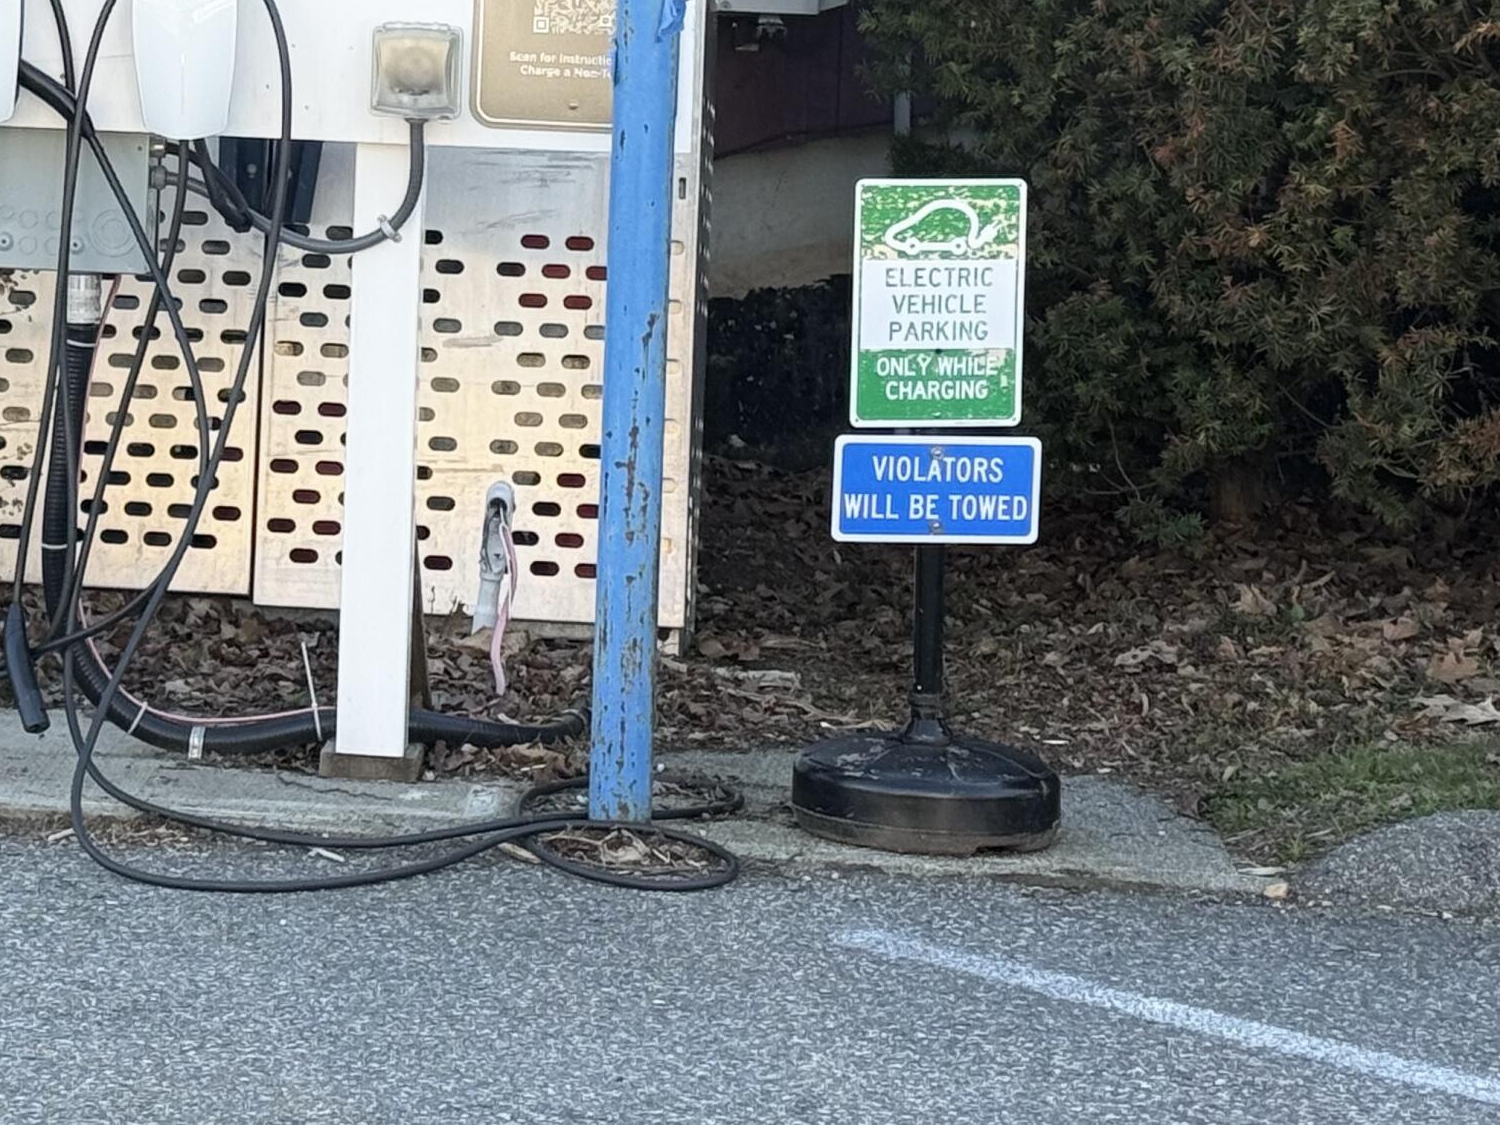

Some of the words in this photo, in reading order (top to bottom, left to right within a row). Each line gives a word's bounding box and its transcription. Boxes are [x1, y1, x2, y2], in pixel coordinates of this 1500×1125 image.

[509, 51, 537, 62] Scan
[540, 52, 557, 63] for
[520, 65, 561, 78] Charge
[563, 69, 571, 77] a
[885, 267, 993, 288] ELECTRIC
[892, 294, 987, 315] VEHICLE
[888, 321, 989, 342] PARKING
[876, 356, 934, 377] ONLY
[938, 356, 999, 376] WHILE
[885, 380, 988, 401] CHARGING
[872, 455, 1004, 483] VIOLATORS
[844, 493, 899, 520] WILL
[909, 493, 940, 521] BE
[949, 494, 1028, 522] TOWED
